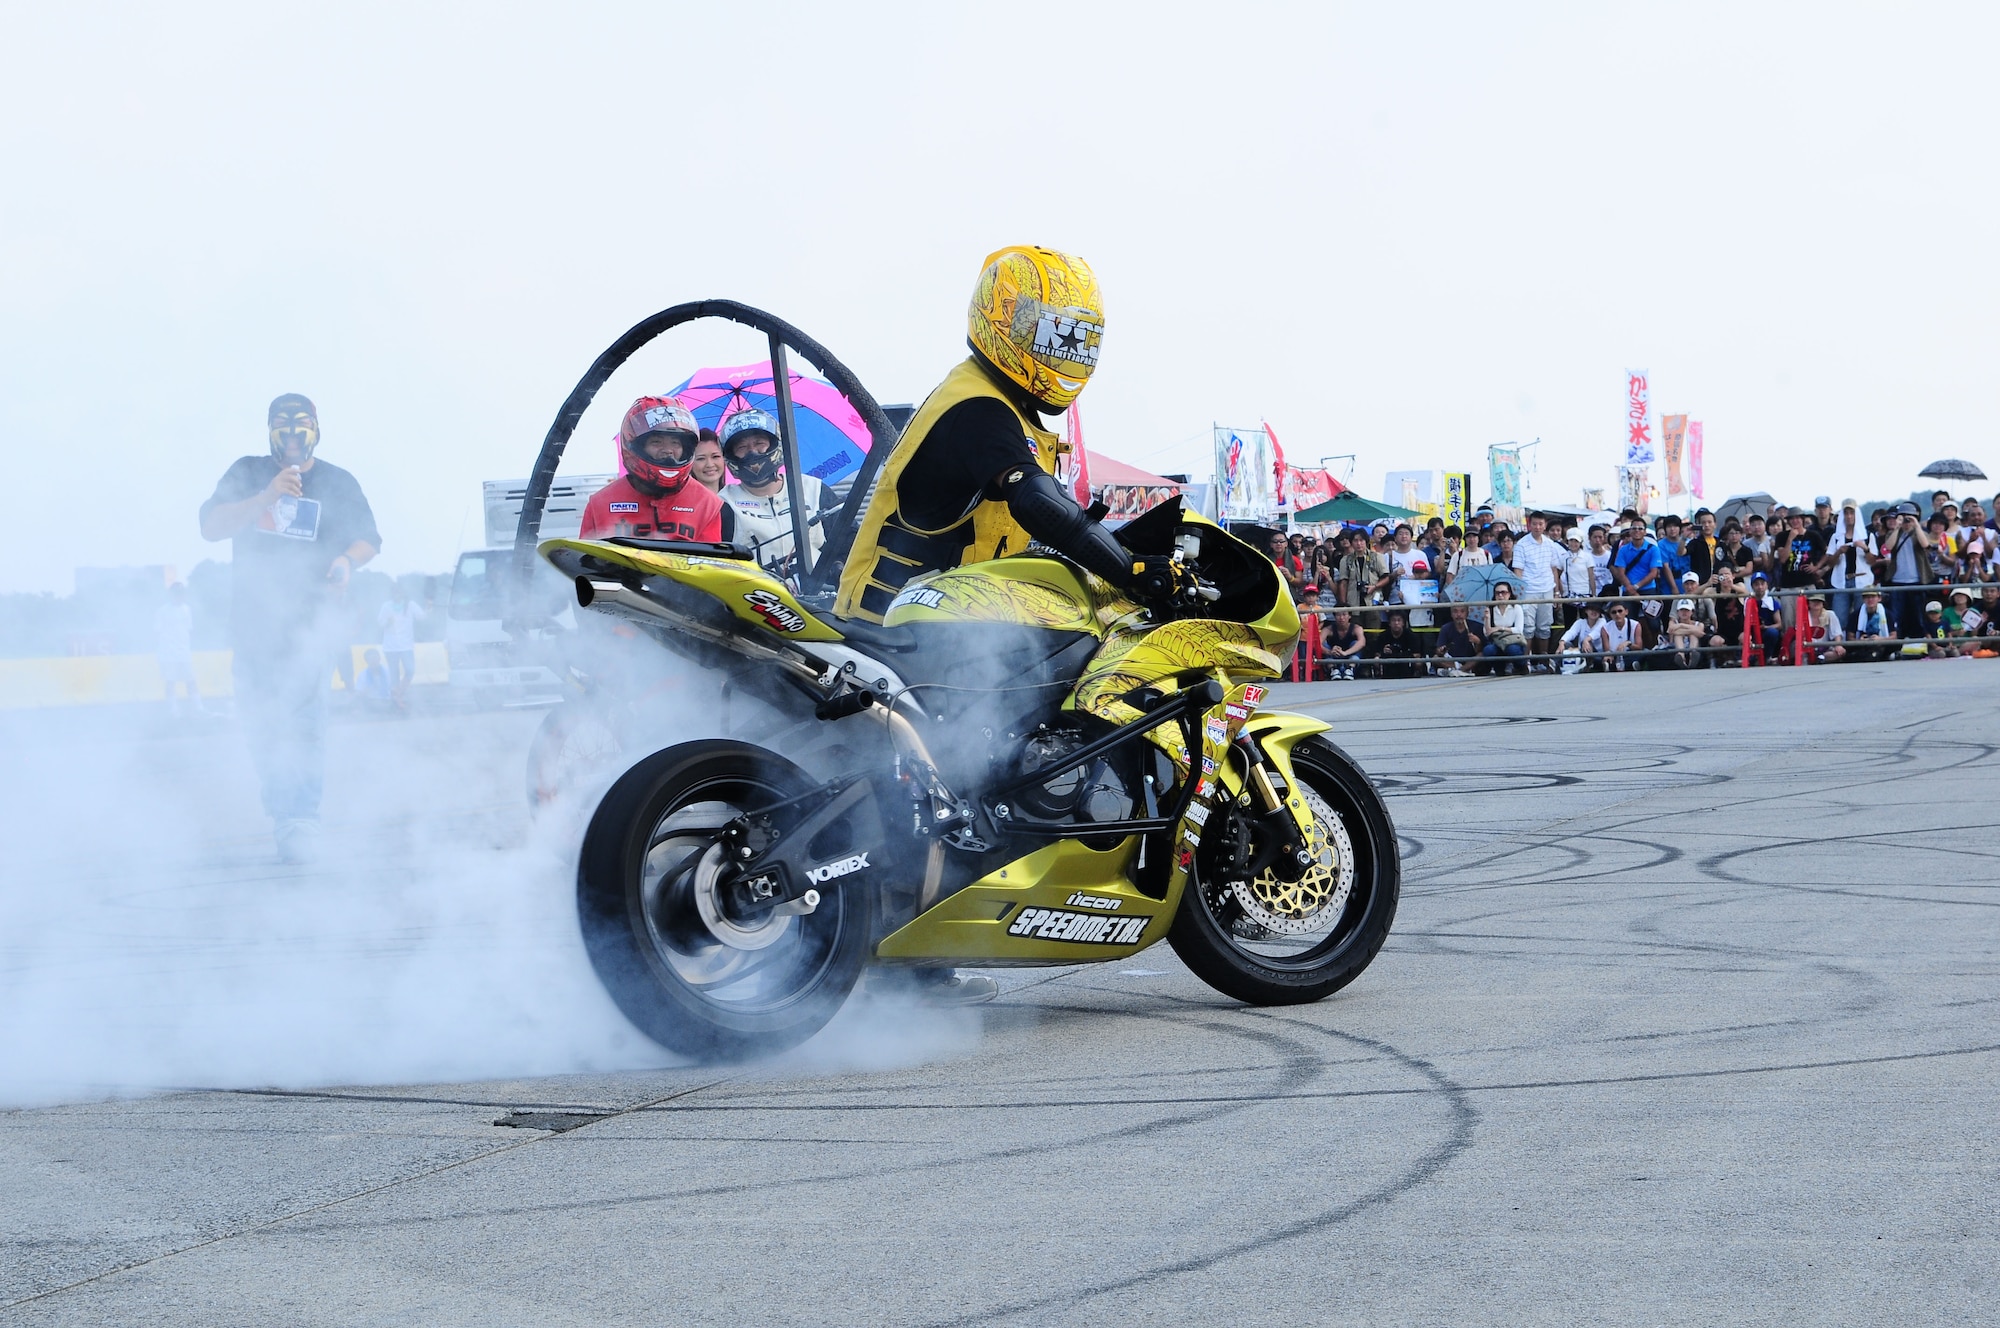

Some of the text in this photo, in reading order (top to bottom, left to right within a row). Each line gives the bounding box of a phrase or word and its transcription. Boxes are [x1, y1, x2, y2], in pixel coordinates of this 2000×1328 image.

[1244, 687, 1262, 703] EK
[1183, 748, 1214, 769] PTS
[805, 851, 871, 886] VORTEX
[1008, 908, 1150, 943] SPEEDMETAL
